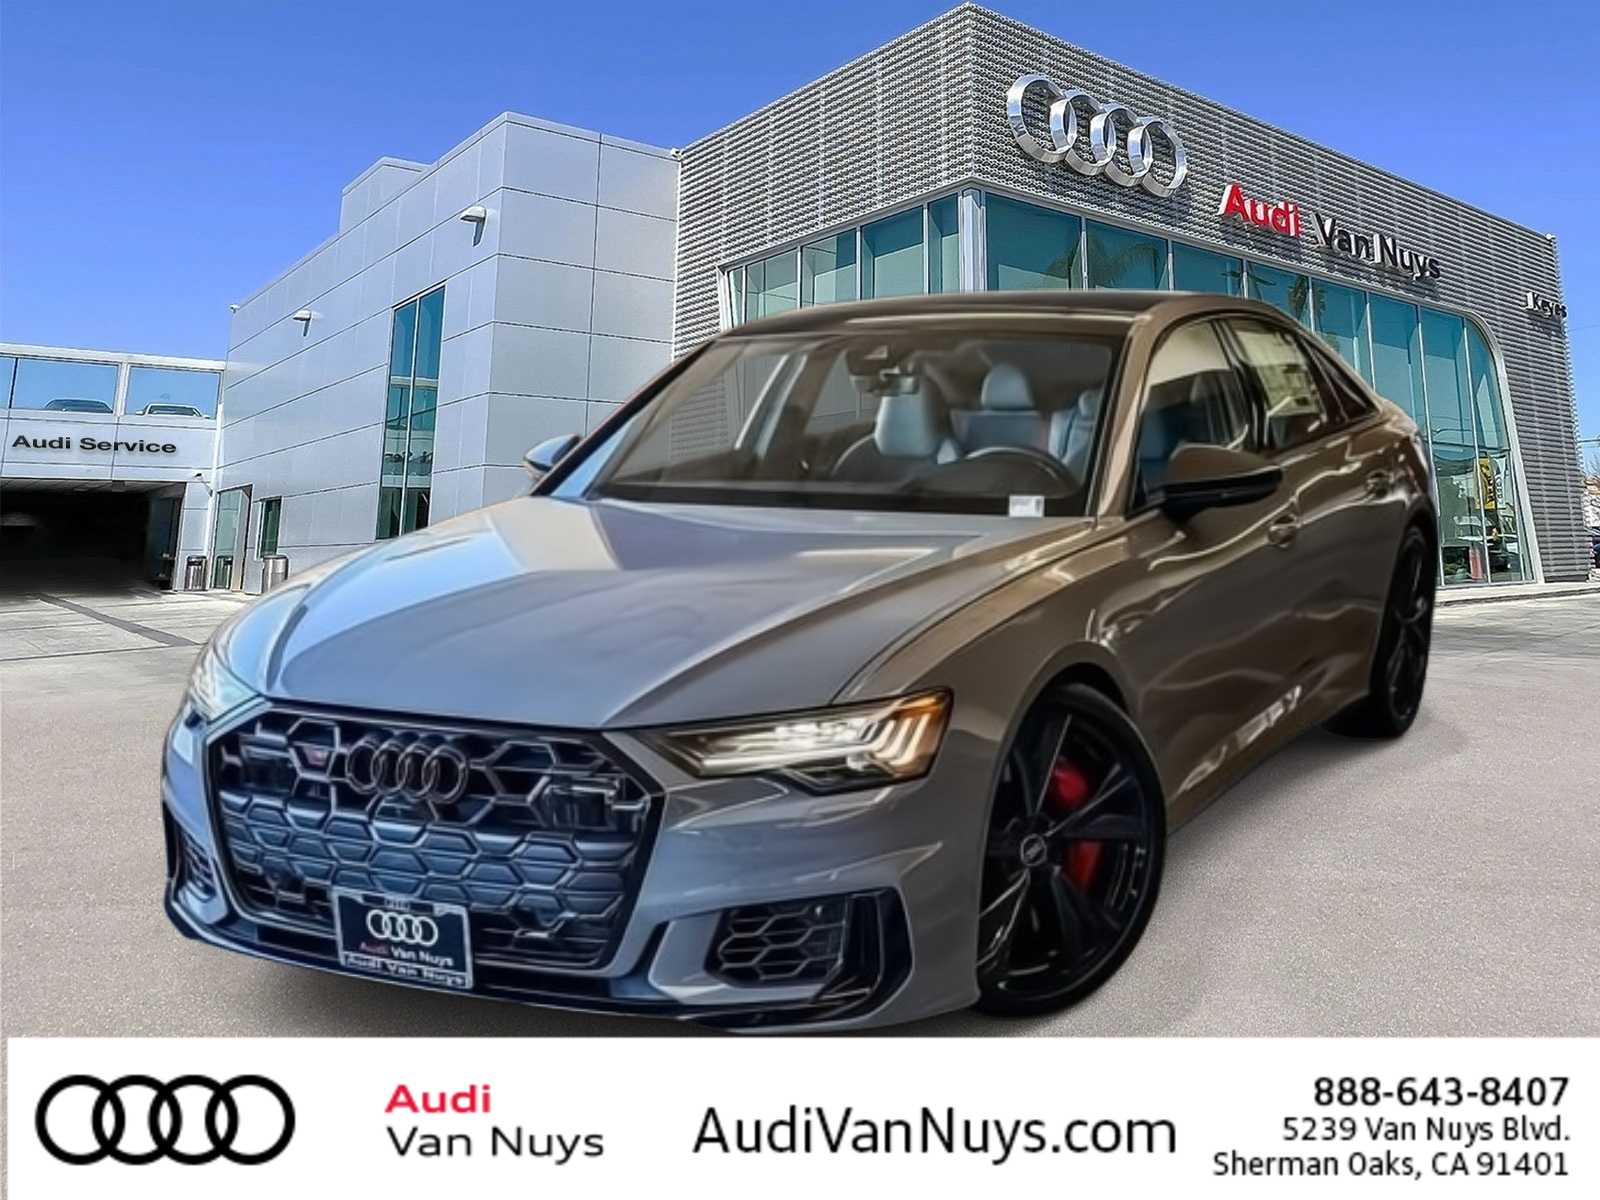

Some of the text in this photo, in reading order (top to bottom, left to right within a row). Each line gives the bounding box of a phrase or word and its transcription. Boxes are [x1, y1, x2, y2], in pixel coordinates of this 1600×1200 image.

[1218, 183, 1441, 280] Audi Van Nuys
[1526, 291, 1568, 319] Keyes
[12, 435, 177, 453] Audi Service
[391, 946, 417, 960] Van
[419, 951, 454, 967] Nuys
